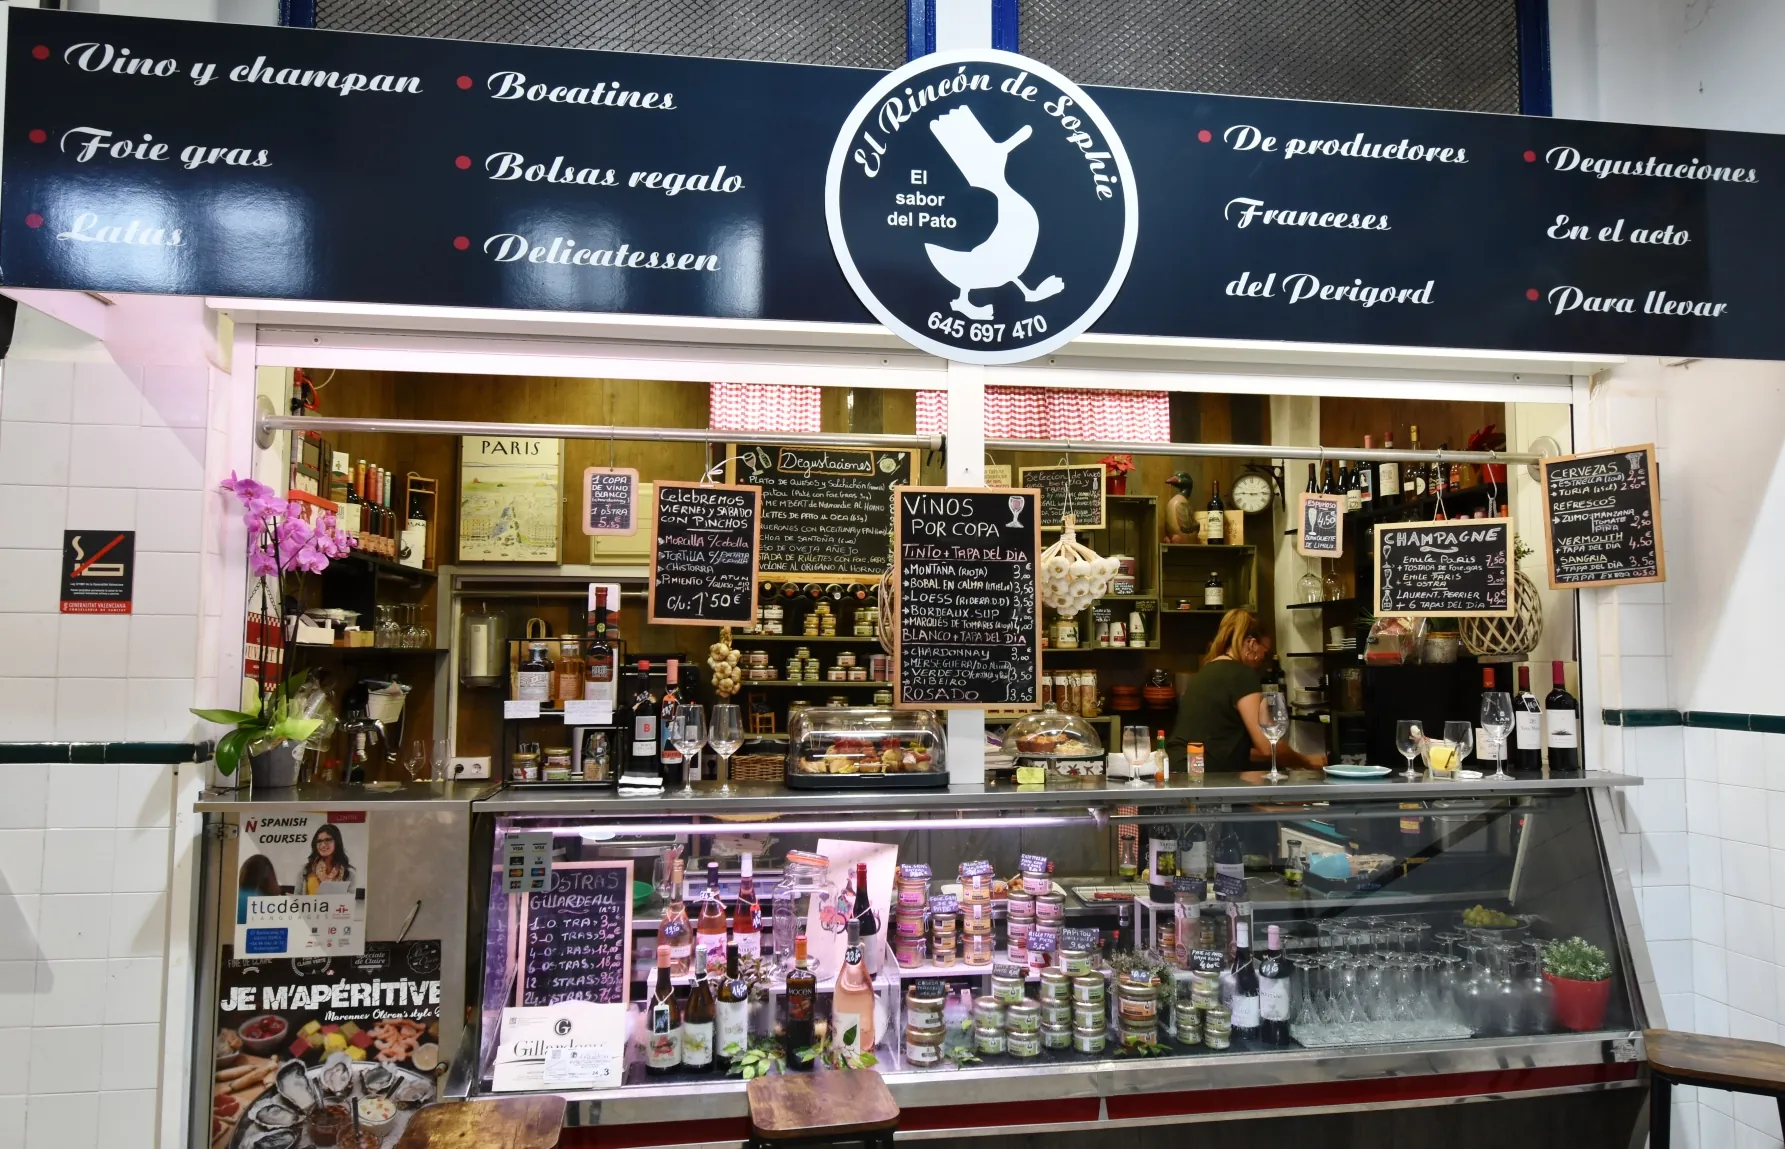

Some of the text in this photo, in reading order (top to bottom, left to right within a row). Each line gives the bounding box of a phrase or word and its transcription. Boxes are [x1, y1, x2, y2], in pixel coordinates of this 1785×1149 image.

[64, 42, 423, 96] Vino y champan
[487, 70, 677, 110] Bocatines
[854, 66, 1117, 200] El Rincón de Sophie
[60, 126, 273, 170] Foie gras
[1223, 124, 1469, 165] De productores
[1546, 145, 1759, 185] Degustaciones
[485, 151, 746, 198] Bolsas regalo
[911, 169, 927, 184] El
[895, 192, 945, 207] sabor
[887, 212, 957, 228] del Pato
[1224, 197, 1392, 231] Franceses
[56, 212, 187, 248] Latas
[1547, 215, 1691, 247] En el acto
[484, 233, 721, 273] Delicatessen
[1225, 271, 1435, 308] del Perigord
[1548, 285, 1728, 319] Para llevar
[928, 312, 1048, 342] 645 697 470
[481, 440, 541, 456] PARIS
[780, 452, 872, 478] Degustaciones
[1550, 462, 1618, 480] CERVEZAS
[602, 476, 627, 484] COPA
[749, 475, 775, 485] PLATO
[1553, 496, 1616, 511] REFRESCOS
[661, 516, 688, 524] CON
[911, 519, 1000, 537] POR COPA
[1383, 527, 1501, 547] CHAMPAGNE
[951, 546, 980, 559] TAPA
[983, 546, 1002, 560] DEL
[1562, 545, 1586, 553] TAPA
[910, 561, 956, 576] MONTAÑA
[1589, 563, 1605, 571] DEL
[910, 578, 940, 590] BOBAL
[943, 580, 955, 591] EN
[1562, 573, 1595, 582] TAPA
[910, 590, 953, 604] LOESS
[1408, 600, 1416, 609] 6
[902, 628, 951, 641] BLANCO
[985, 632, 1002, 642] DEL
[902, 686, 979, 702] ROSADO
[643, 723, 651, 733] B
[260, 817, 308, 828] SPANISH
[259, 834, 308, 844] COURSES
[251, 899, 329, 915] tlcdénia
[364, 957, 386, 965] Claire
[220, 986, 257, 1012] JE
[324, 1011, 370, 1021] Marennes
[410, 1010, 433, 1020] style
